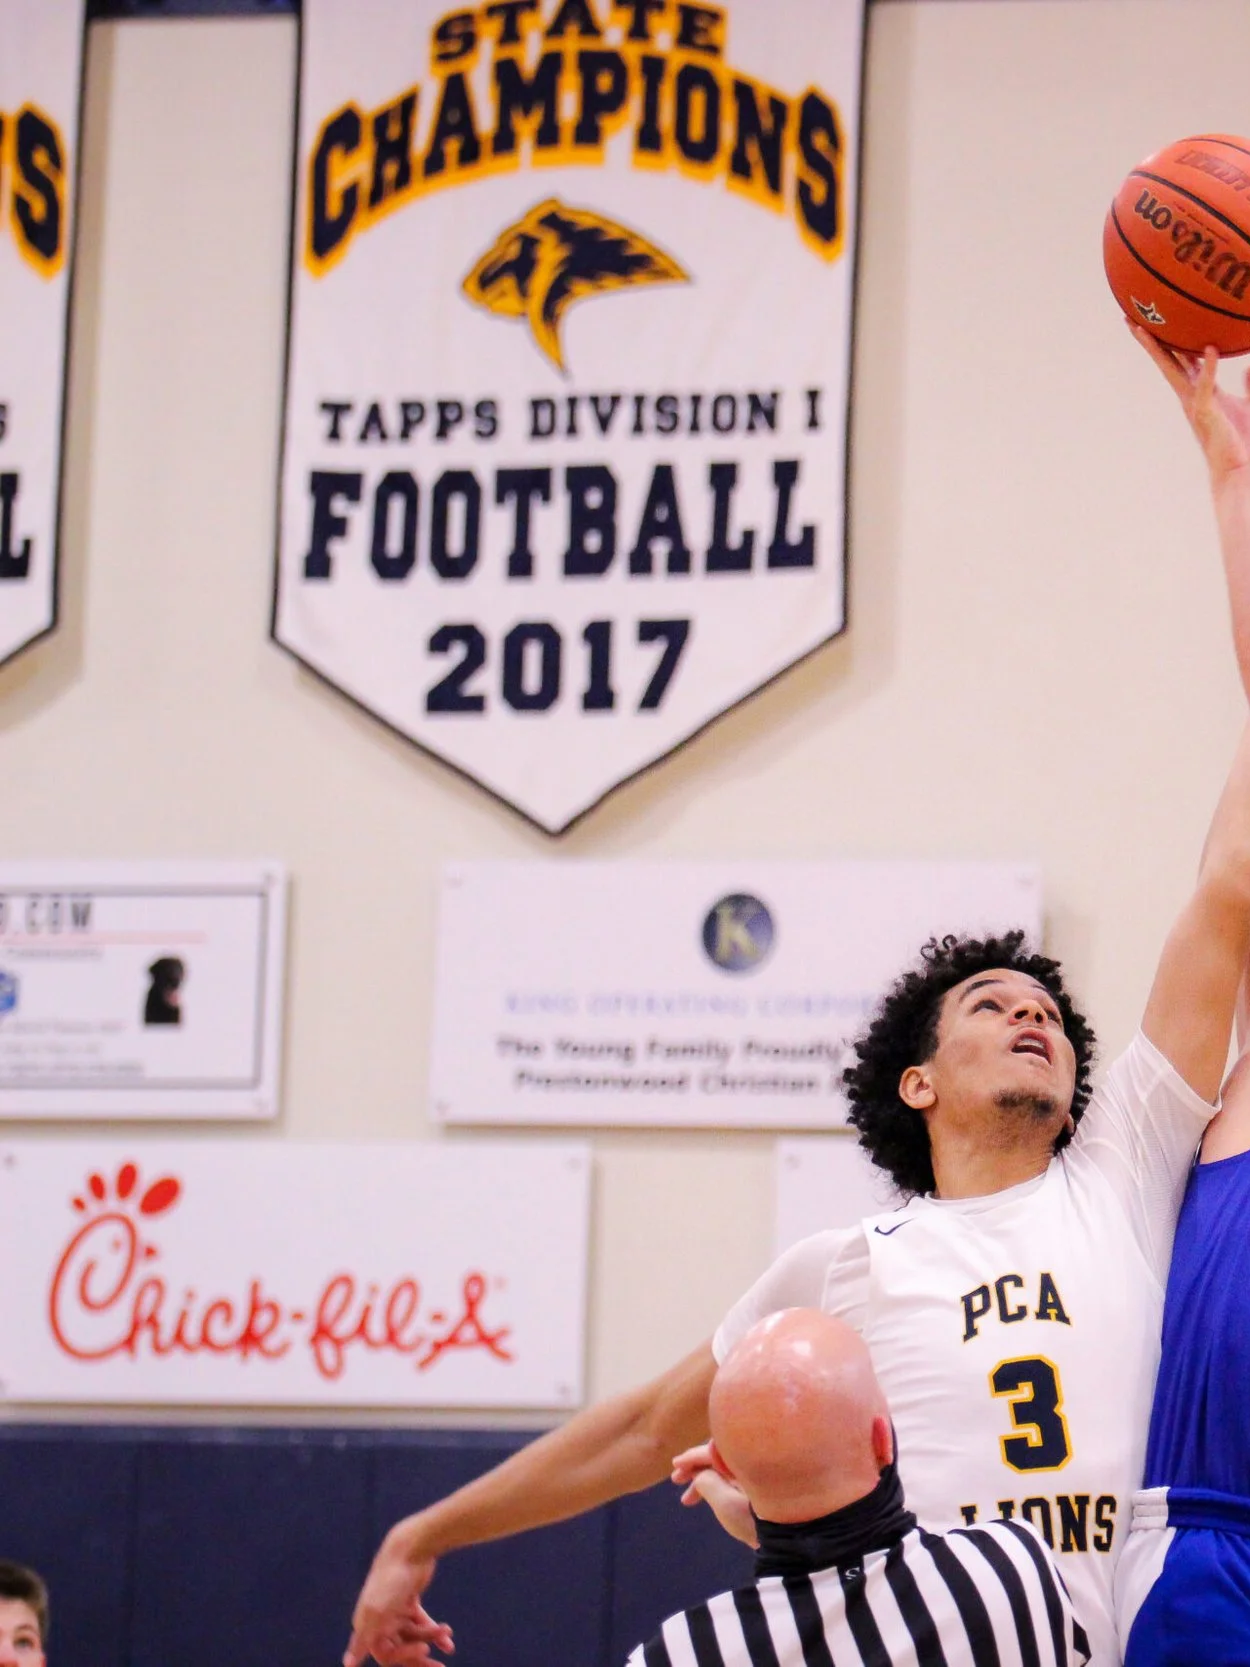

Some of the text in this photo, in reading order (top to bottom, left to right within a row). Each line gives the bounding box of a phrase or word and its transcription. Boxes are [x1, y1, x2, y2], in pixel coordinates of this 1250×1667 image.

[430, 0, 726, 70] STATE
[0, 98, 67, 280] S
[303, 50, 843, 280] CHAMPIONS
[319, 390, 823, 443] TAPPS DIVISION I
[302, 458, 818, 582] FOOTBALL
[424, 618, 693, 715] 2017
[49, 1208, 515, 1381] Chick-fil-A
[959, 1271, 1073, 1343] PCA
[988, 1353, 1073, 1475] 3
